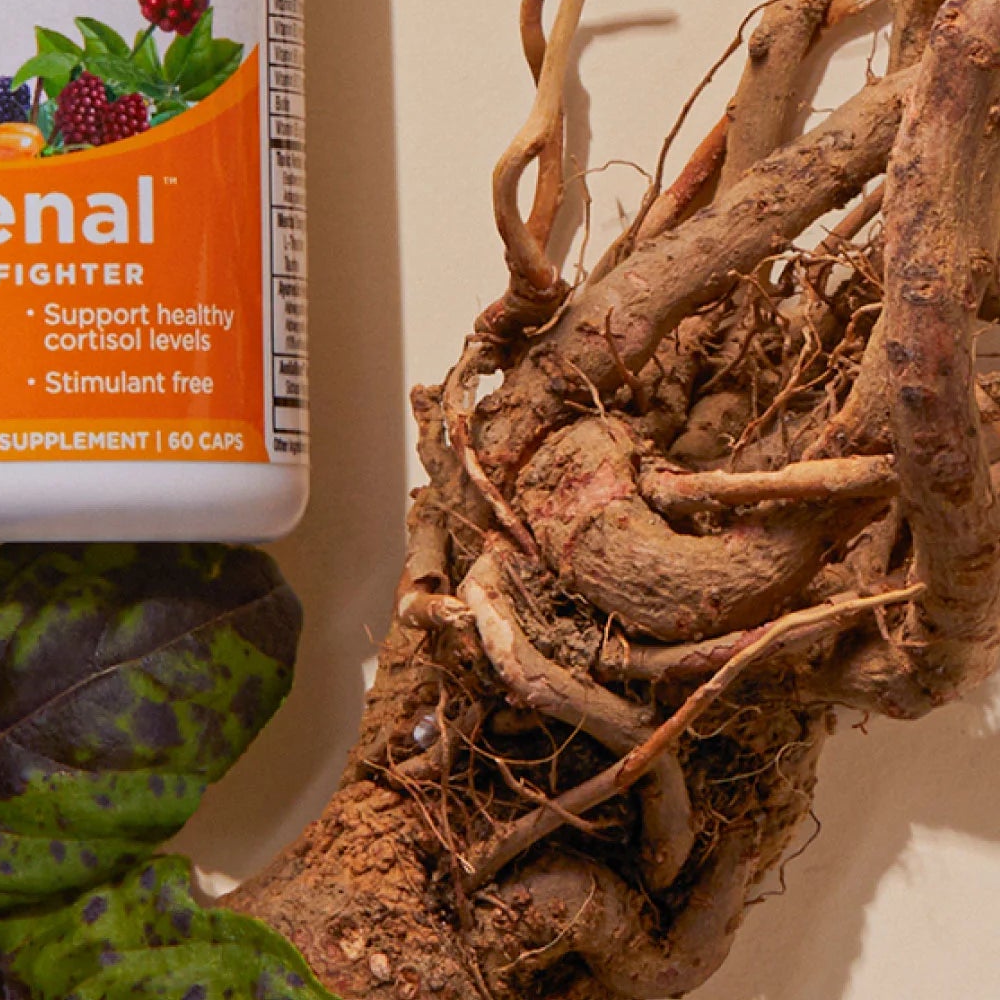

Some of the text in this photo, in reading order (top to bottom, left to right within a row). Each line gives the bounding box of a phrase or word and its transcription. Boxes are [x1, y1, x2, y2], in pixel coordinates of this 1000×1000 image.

[43, 303, 234, 331] Support healthy
[44, 328, 211, 352] cortisol levels
[45, 371, 214, 394] Stimulant free
[167, 431, 194, 450] 60
[199, 431, 244, 451] CAPS
